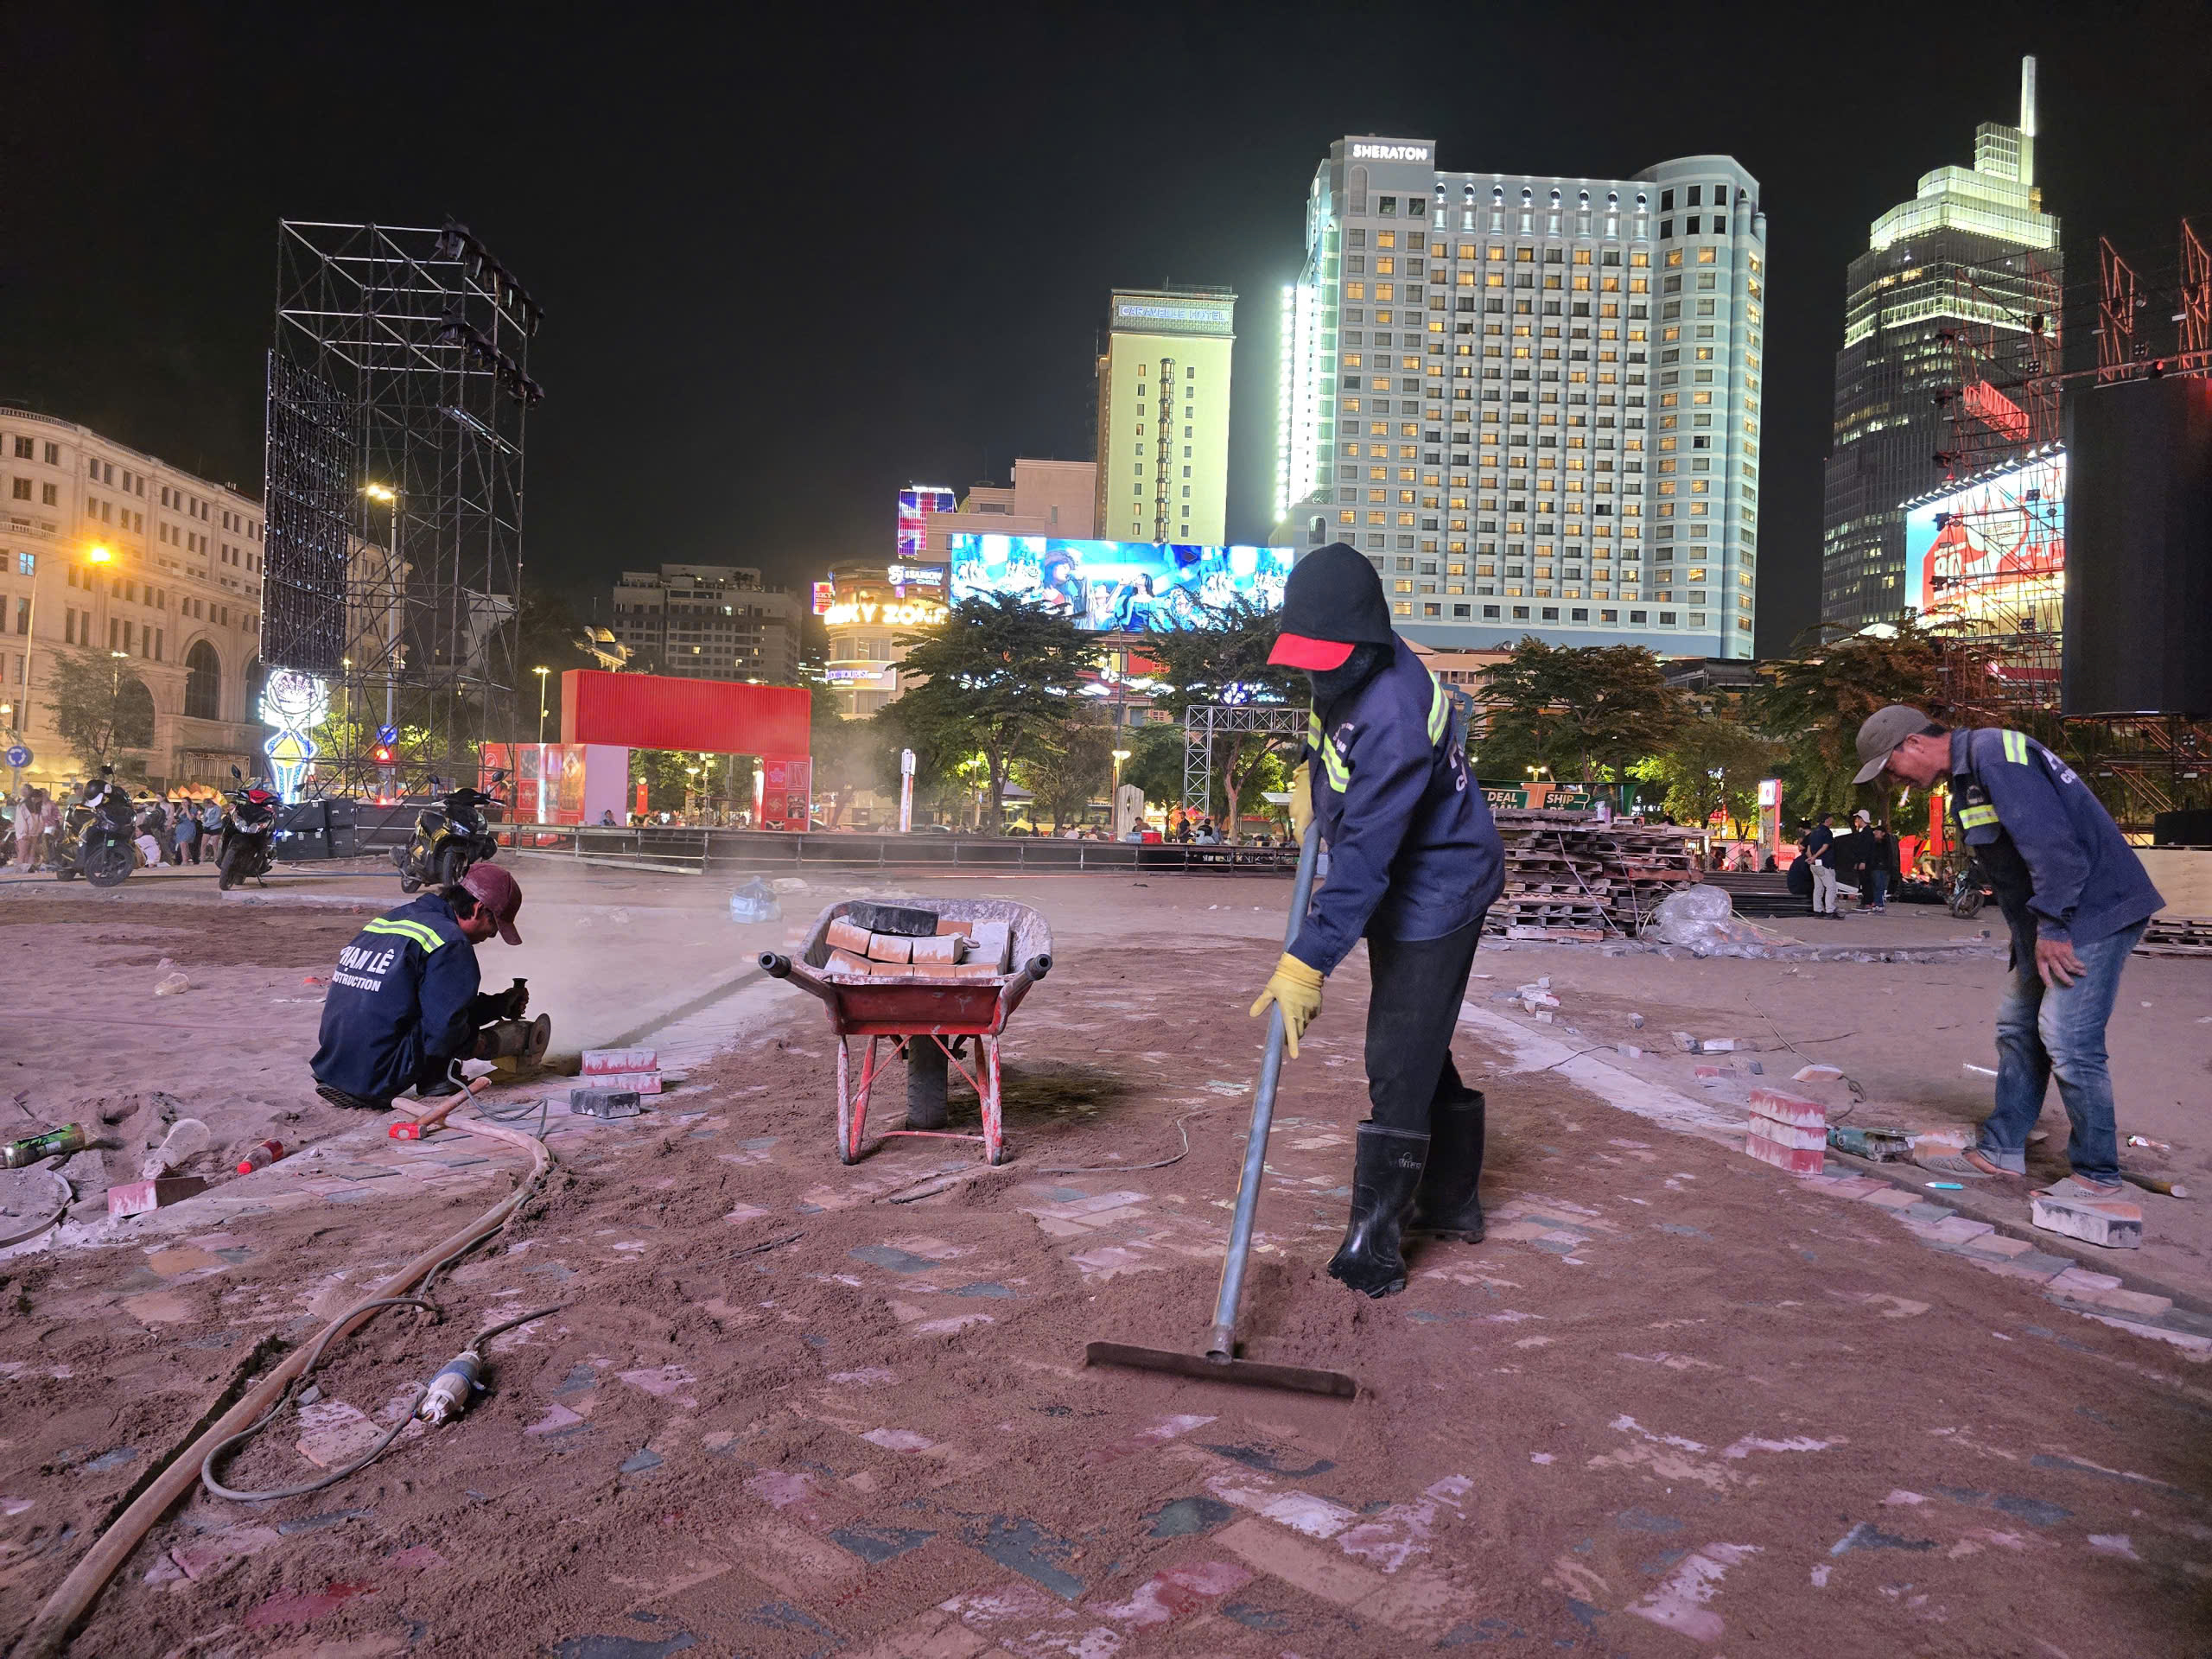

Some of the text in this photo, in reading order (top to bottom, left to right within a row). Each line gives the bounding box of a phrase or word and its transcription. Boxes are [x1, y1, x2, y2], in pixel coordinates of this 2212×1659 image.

[1352, 143, 1427, 162] SHERATON
[1122, 305, 1226, 321] CARAVELLE HOTEL
[1487, 791, 1518, 803] DEAL
[1546, 793, 1574, 804] SHIP
[366, 949, 395, 975] LÊ
